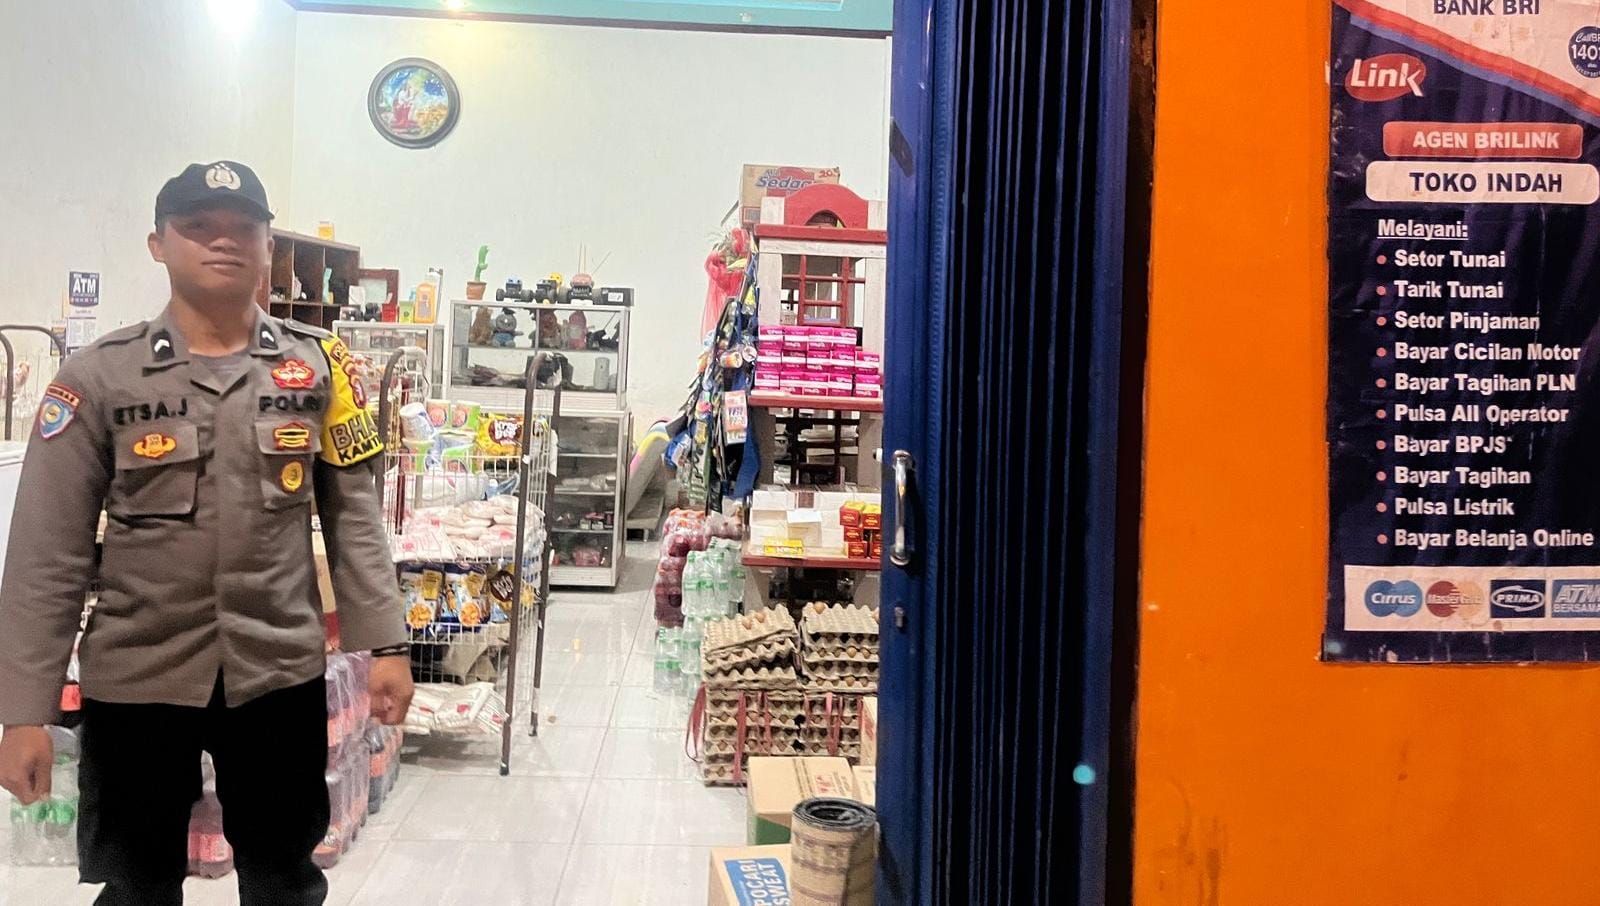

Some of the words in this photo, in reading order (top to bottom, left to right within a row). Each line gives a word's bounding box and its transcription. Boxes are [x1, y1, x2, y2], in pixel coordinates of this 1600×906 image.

[1434, 0, 1494, 15] BANK
[1502, 0, 1540, 15] BRI
[1350, 58, 1424, 97] Link
[1413, 131, 1468, 149] AGEN
[1474, 131, 1560, 149] BRILINK
[1409, 172, 1477, 192] TOKO
[1487, 172, 1563, 193] INDAH
[1377, 219, 1469, 240] Melayani:
[1394, 249, 1445, 268] Setor
[1450, 250, 1506, 268] Tunai
[73, 278, 97, 294] ATM
[1394, 280, 1442, 298] Tarik
[1447, 281, 1504, 299] Tunai
[1394, 311, 1445, 329] Setor
[1450, 312, 1541, 333] Pinjaman
[1394, 342, 1449, 363] Bayar
[1454, 343, 1522, 361] Cicilan
[1527, 343, 1581, 361] Motor
[1394, 373, 1450, 394] Bayar
[1454, 374, 1531, 395] Tagihan
[1536, 374, 1576, 391] PLN
[1394, 404, 1446, 422] Pulsa
[1452, 404, 1480, 422] All
[1486, 405, 1569, 426] Operator
[1394, 435, 1450, 456] Bayar
[1394, 466, 1450, 487] Bayar
[1454, 467, 1532, 488] Tagihan
[1394, 498, 1448, 515] Pulsa
[1453, 498, 1515, 515] Listrik
[1394, 529, 1450, 550] Bayar
[1455, 529, 1528, 550] Belanja
[1533, 530, 1595, 546] Online
[1371, 592, 1417, 604] Cirrus
[1496, 593, 1541, 604] PRIMA
[737, 860, 772, 906] POCARI
